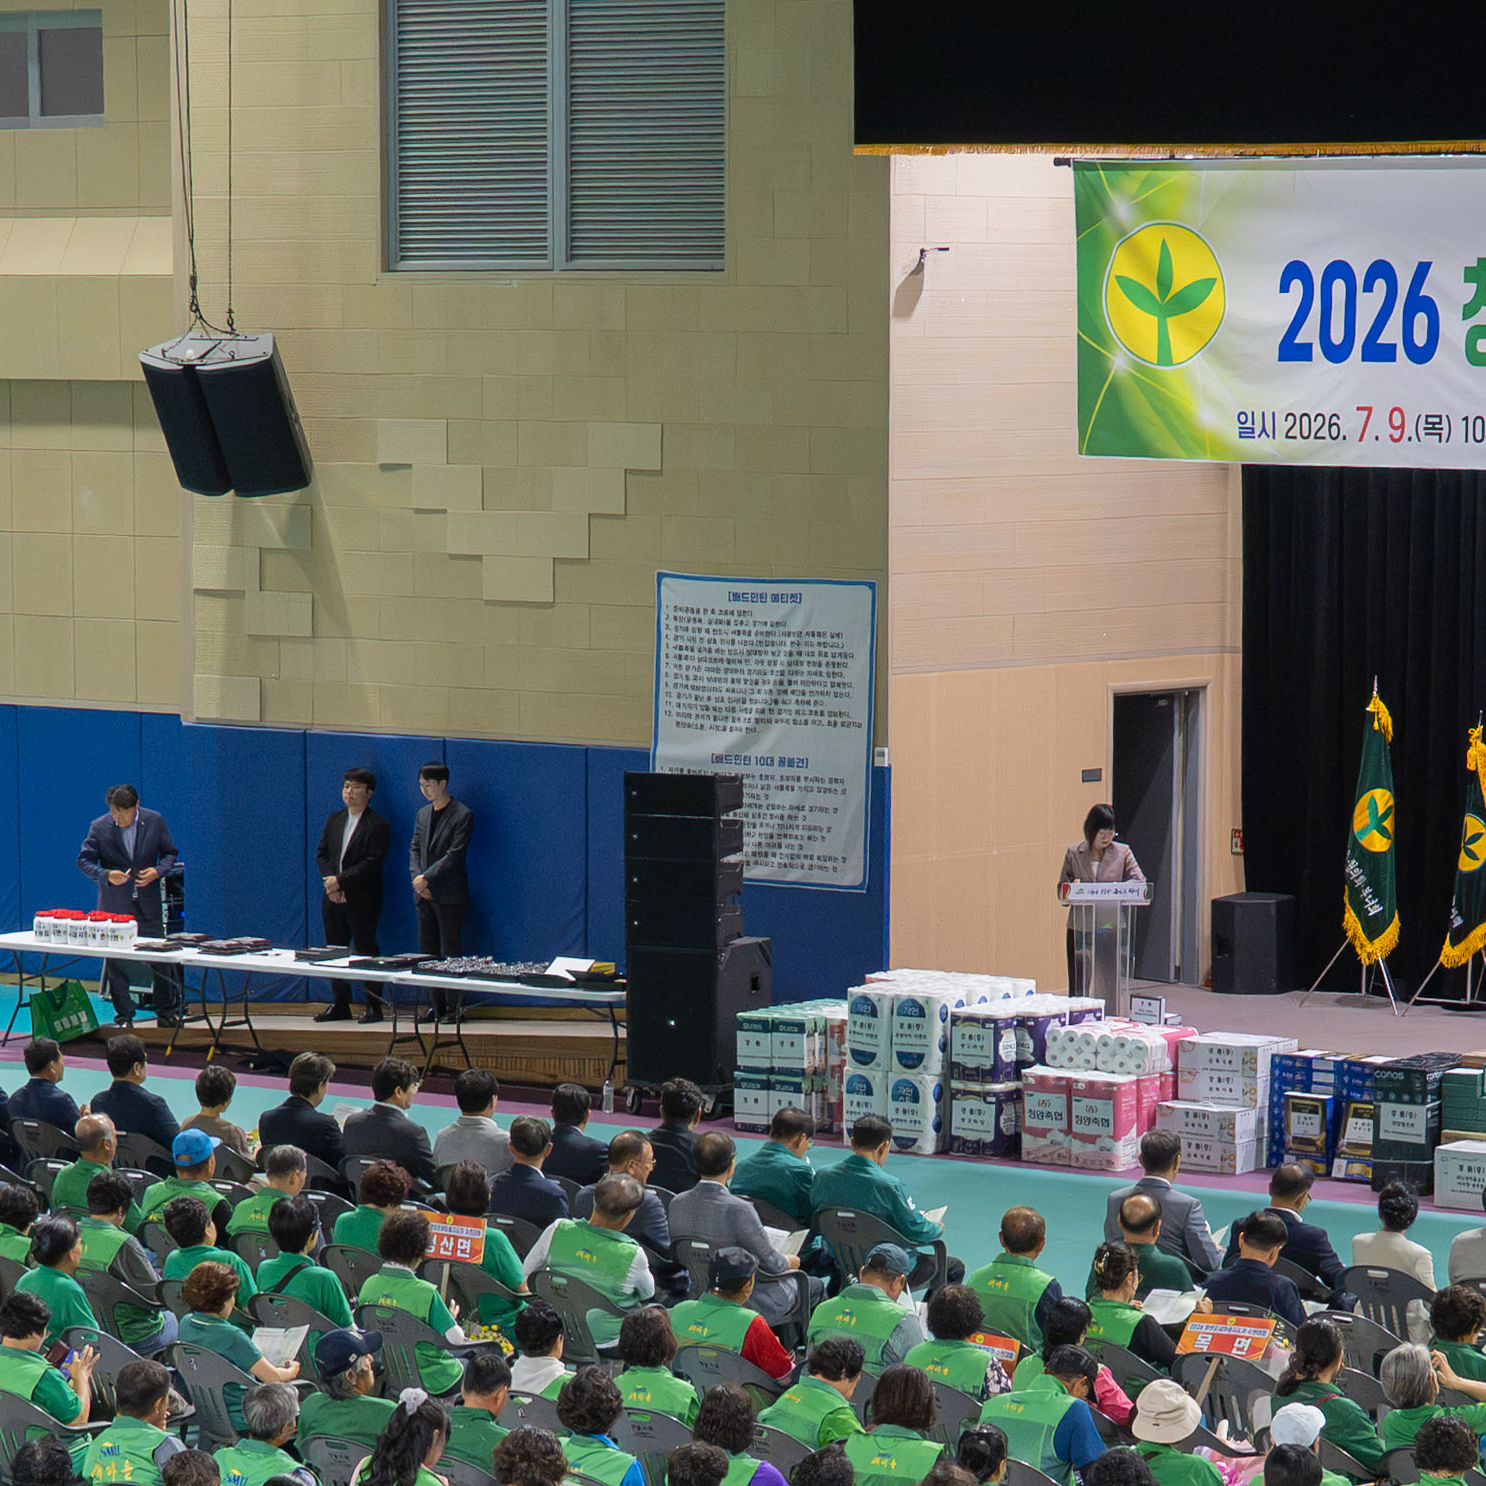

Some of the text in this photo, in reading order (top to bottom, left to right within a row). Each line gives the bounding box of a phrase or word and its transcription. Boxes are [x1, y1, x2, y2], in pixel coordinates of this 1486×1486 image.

[1277, 258, 1441, 366] 2026
[1236, 410, 1277, 442] 일시
[1284, 413, 1348, 442] 2026.
